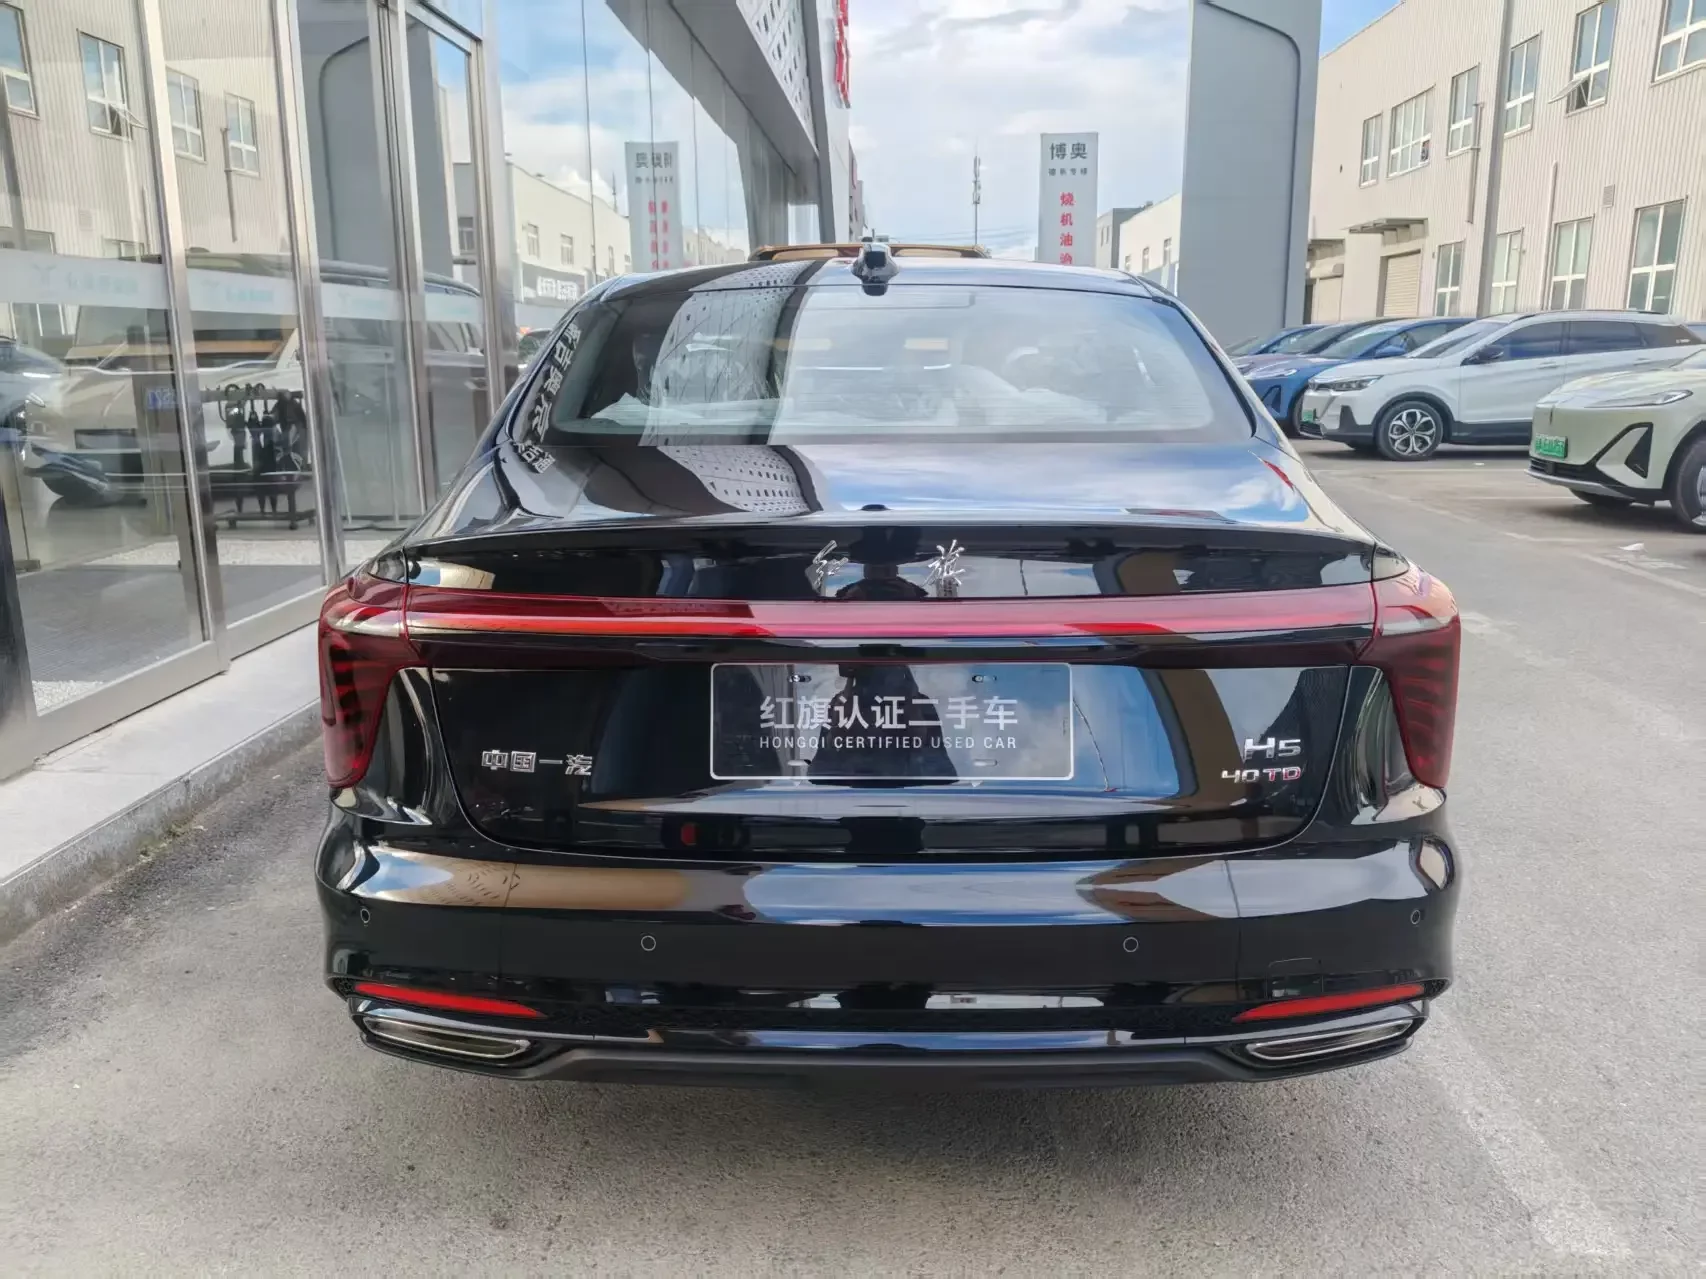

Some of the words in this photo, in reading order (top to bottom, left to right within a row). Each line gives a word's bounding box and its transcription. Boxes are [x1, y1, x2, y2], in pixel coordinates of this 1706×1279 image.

[1049, 142, 1088, 160] 博奥
[759, 695, 1019, 732] 红旗认证二手车
[759, 735, 826, 750] HONGQI
[833, 735, 924, 750] CERTIFIED
[930, 735, 975, 750] USED
[983, 735, 1017, 750] CAR
[1243, 737, 1302, 760] H5
[481, 749, 593, 776] 中国一汽
[1221, 766, 1302, 783] 40TD
